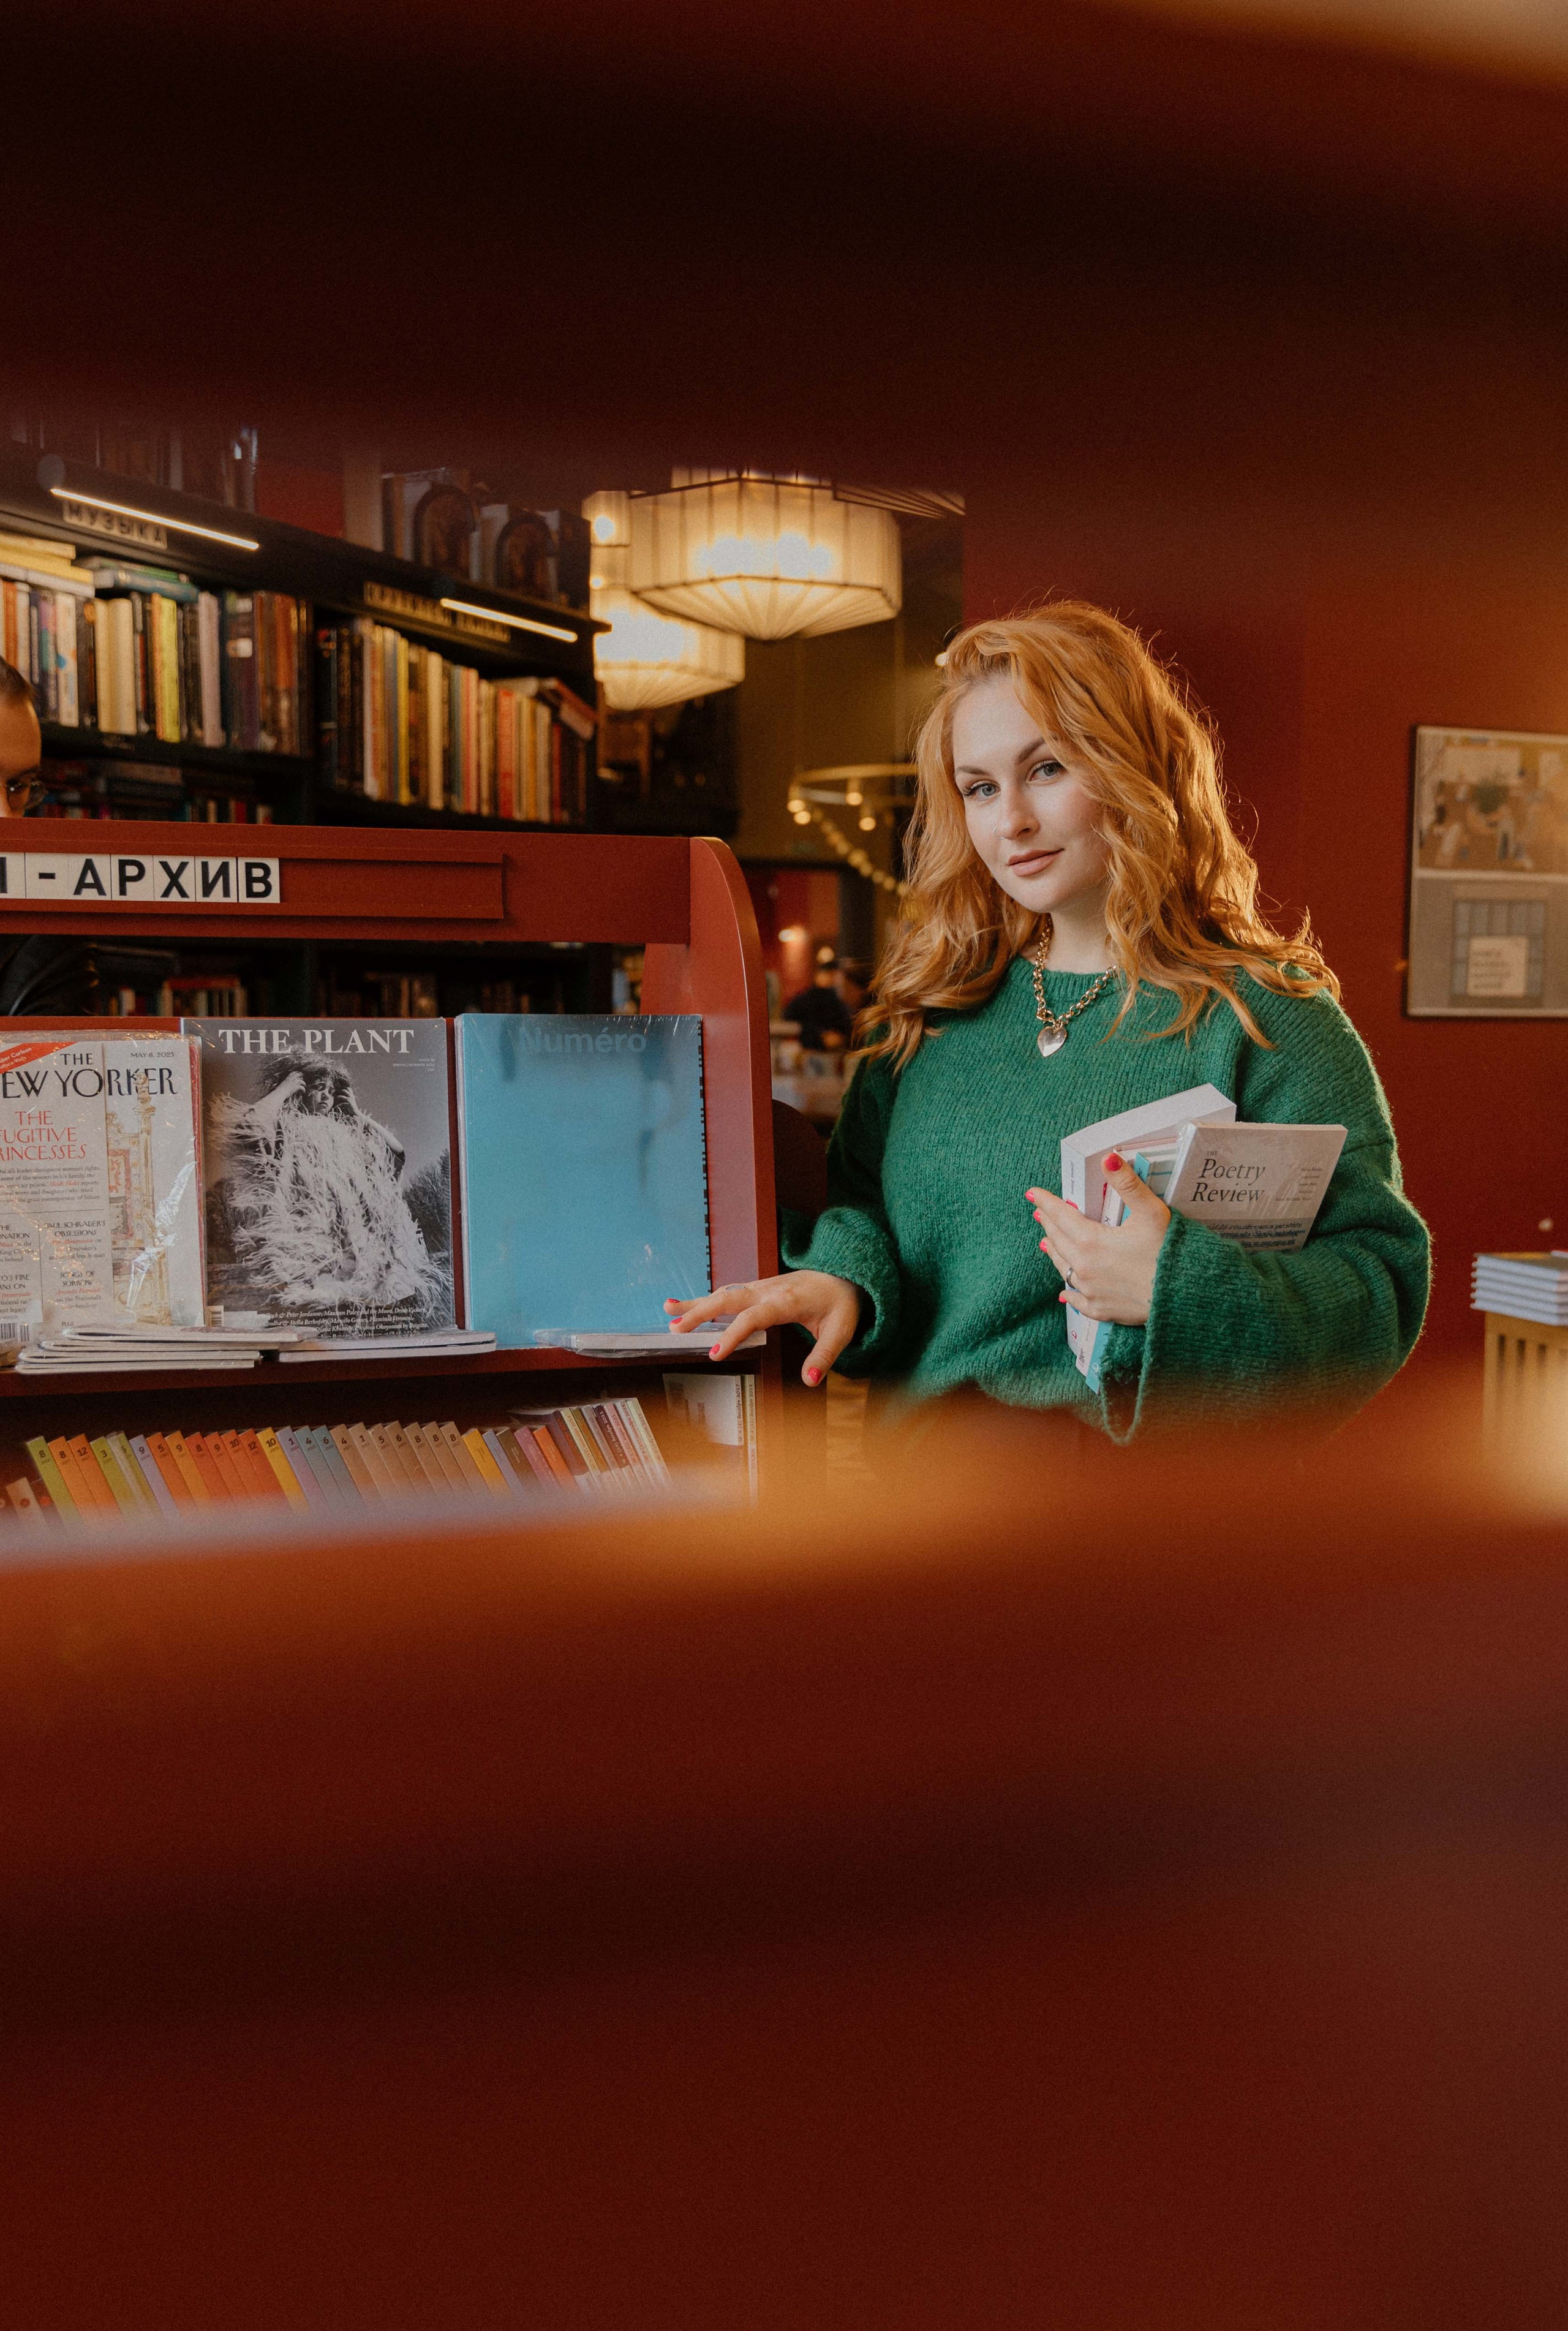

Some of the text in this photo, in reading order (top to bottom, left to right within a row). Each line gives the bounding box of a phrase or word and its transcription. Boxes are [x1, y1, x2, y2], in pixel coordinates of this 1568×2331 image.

[0, 857, 273, 899] -АРХИВ
[218, 1029, 414, 1053] THE PLANT
[521, 1027, 647, 1053] Numéro
[60, 1053, 94, 1065] THE
[54, 1068, 178, 1098] YORKER
[15, 1110, 53, 1125] THE
[1198, 1158, 1266, 1186] Poetry
[1191, 1182, 1265, 1202] Review
[64, 1220, 106, 1228] SCHRADER'S
[55, 1229, 96, 1237] OBSESSIONS
[598, 1410, 608, 1424] 2021
[266, 1437, 276, 1448] 10
[288, 1437, 295, 1446] 1
[306, 1437, 312, 1445] 4
[360, 1434, 366, 1443] 1
[379, 1435, 385, 1444] 5
[396, 1434, 402, 1442] 6
[450, 1434, 456, 1442] 8
[138, 1446, 145, 1455] 9
[158, 1444, 165, 1453] 5
[176, 1443, 183, 1453] 9
[247, 1441, 258, 1451] 12
[39, 1449, 47, 1459] 8
[77, 1446, 88, 1457] 12
[101, 1449, 108, 1458] 3
